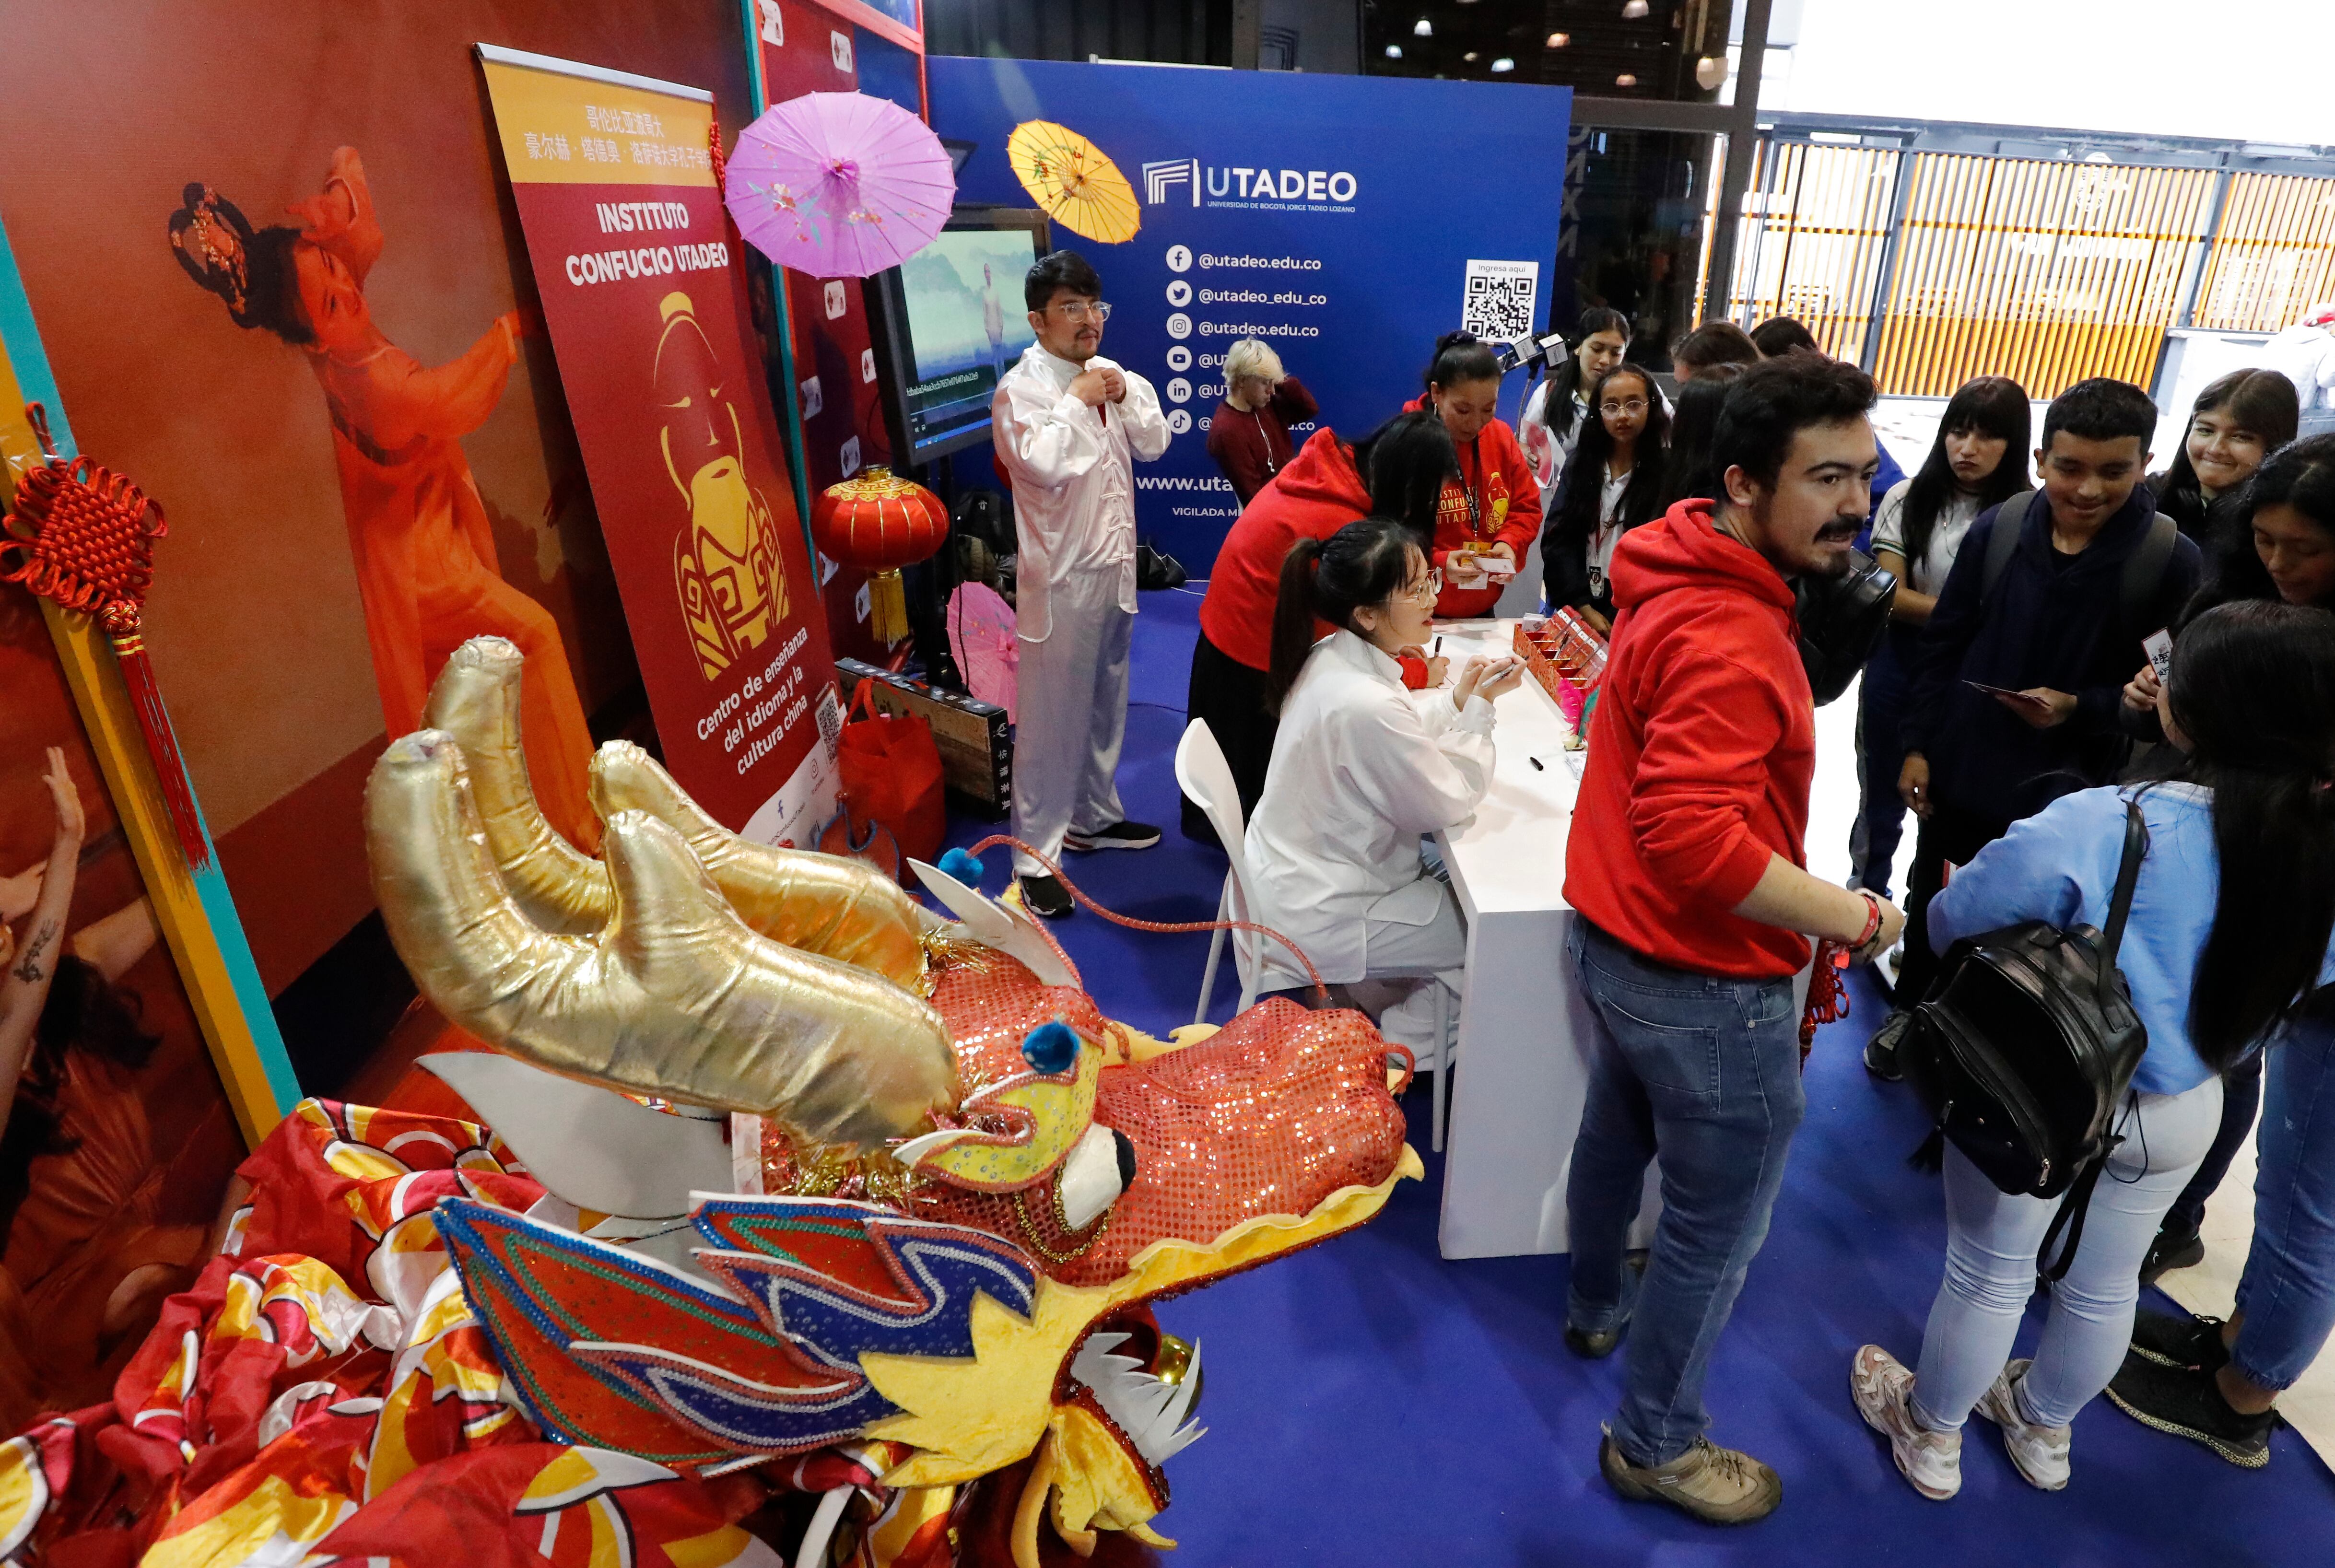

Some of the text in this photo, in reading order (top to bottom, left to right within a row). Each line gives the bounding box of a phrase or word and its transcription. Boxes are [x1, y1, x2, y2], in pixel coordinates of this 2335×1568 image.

[585, 105, 665, 138] 哥伦比亚波哥大
[1207, 166, 1357, 201] UTADEO
[1207, 201, 1249, 209] UNIVERSIDAD
[1260, 202, 1286, 210] BOGOTÁ
[596, 202, 689, 234] INSTITUTO
[565, 242, 728, 286] CONFUCIO UTADEO
[1199, 254, 1322, 270] @utadeo.edu.co
[1478, 264, 1507, 272] Ingresa
[1198, 289, 1327, 305] @utadeo_edu_co
[1198, 321, 1319, 337] @utadeo.edu.co
[1136, 476, 1233, 491] www.uta
[1173, 507, 1225, 517] VIGILADA
[697, 690, 740, 741] Centro
[742, 675, 763, 699] de
[764, 626, 808, 683] enseñanza
[724, 718, 745, 753] del
[748, 683, 788, 733] idioma
[786, 677, 795, 696] y
[793, 665, 804, 681] la
[737, 694, 808, 775] cultura china
